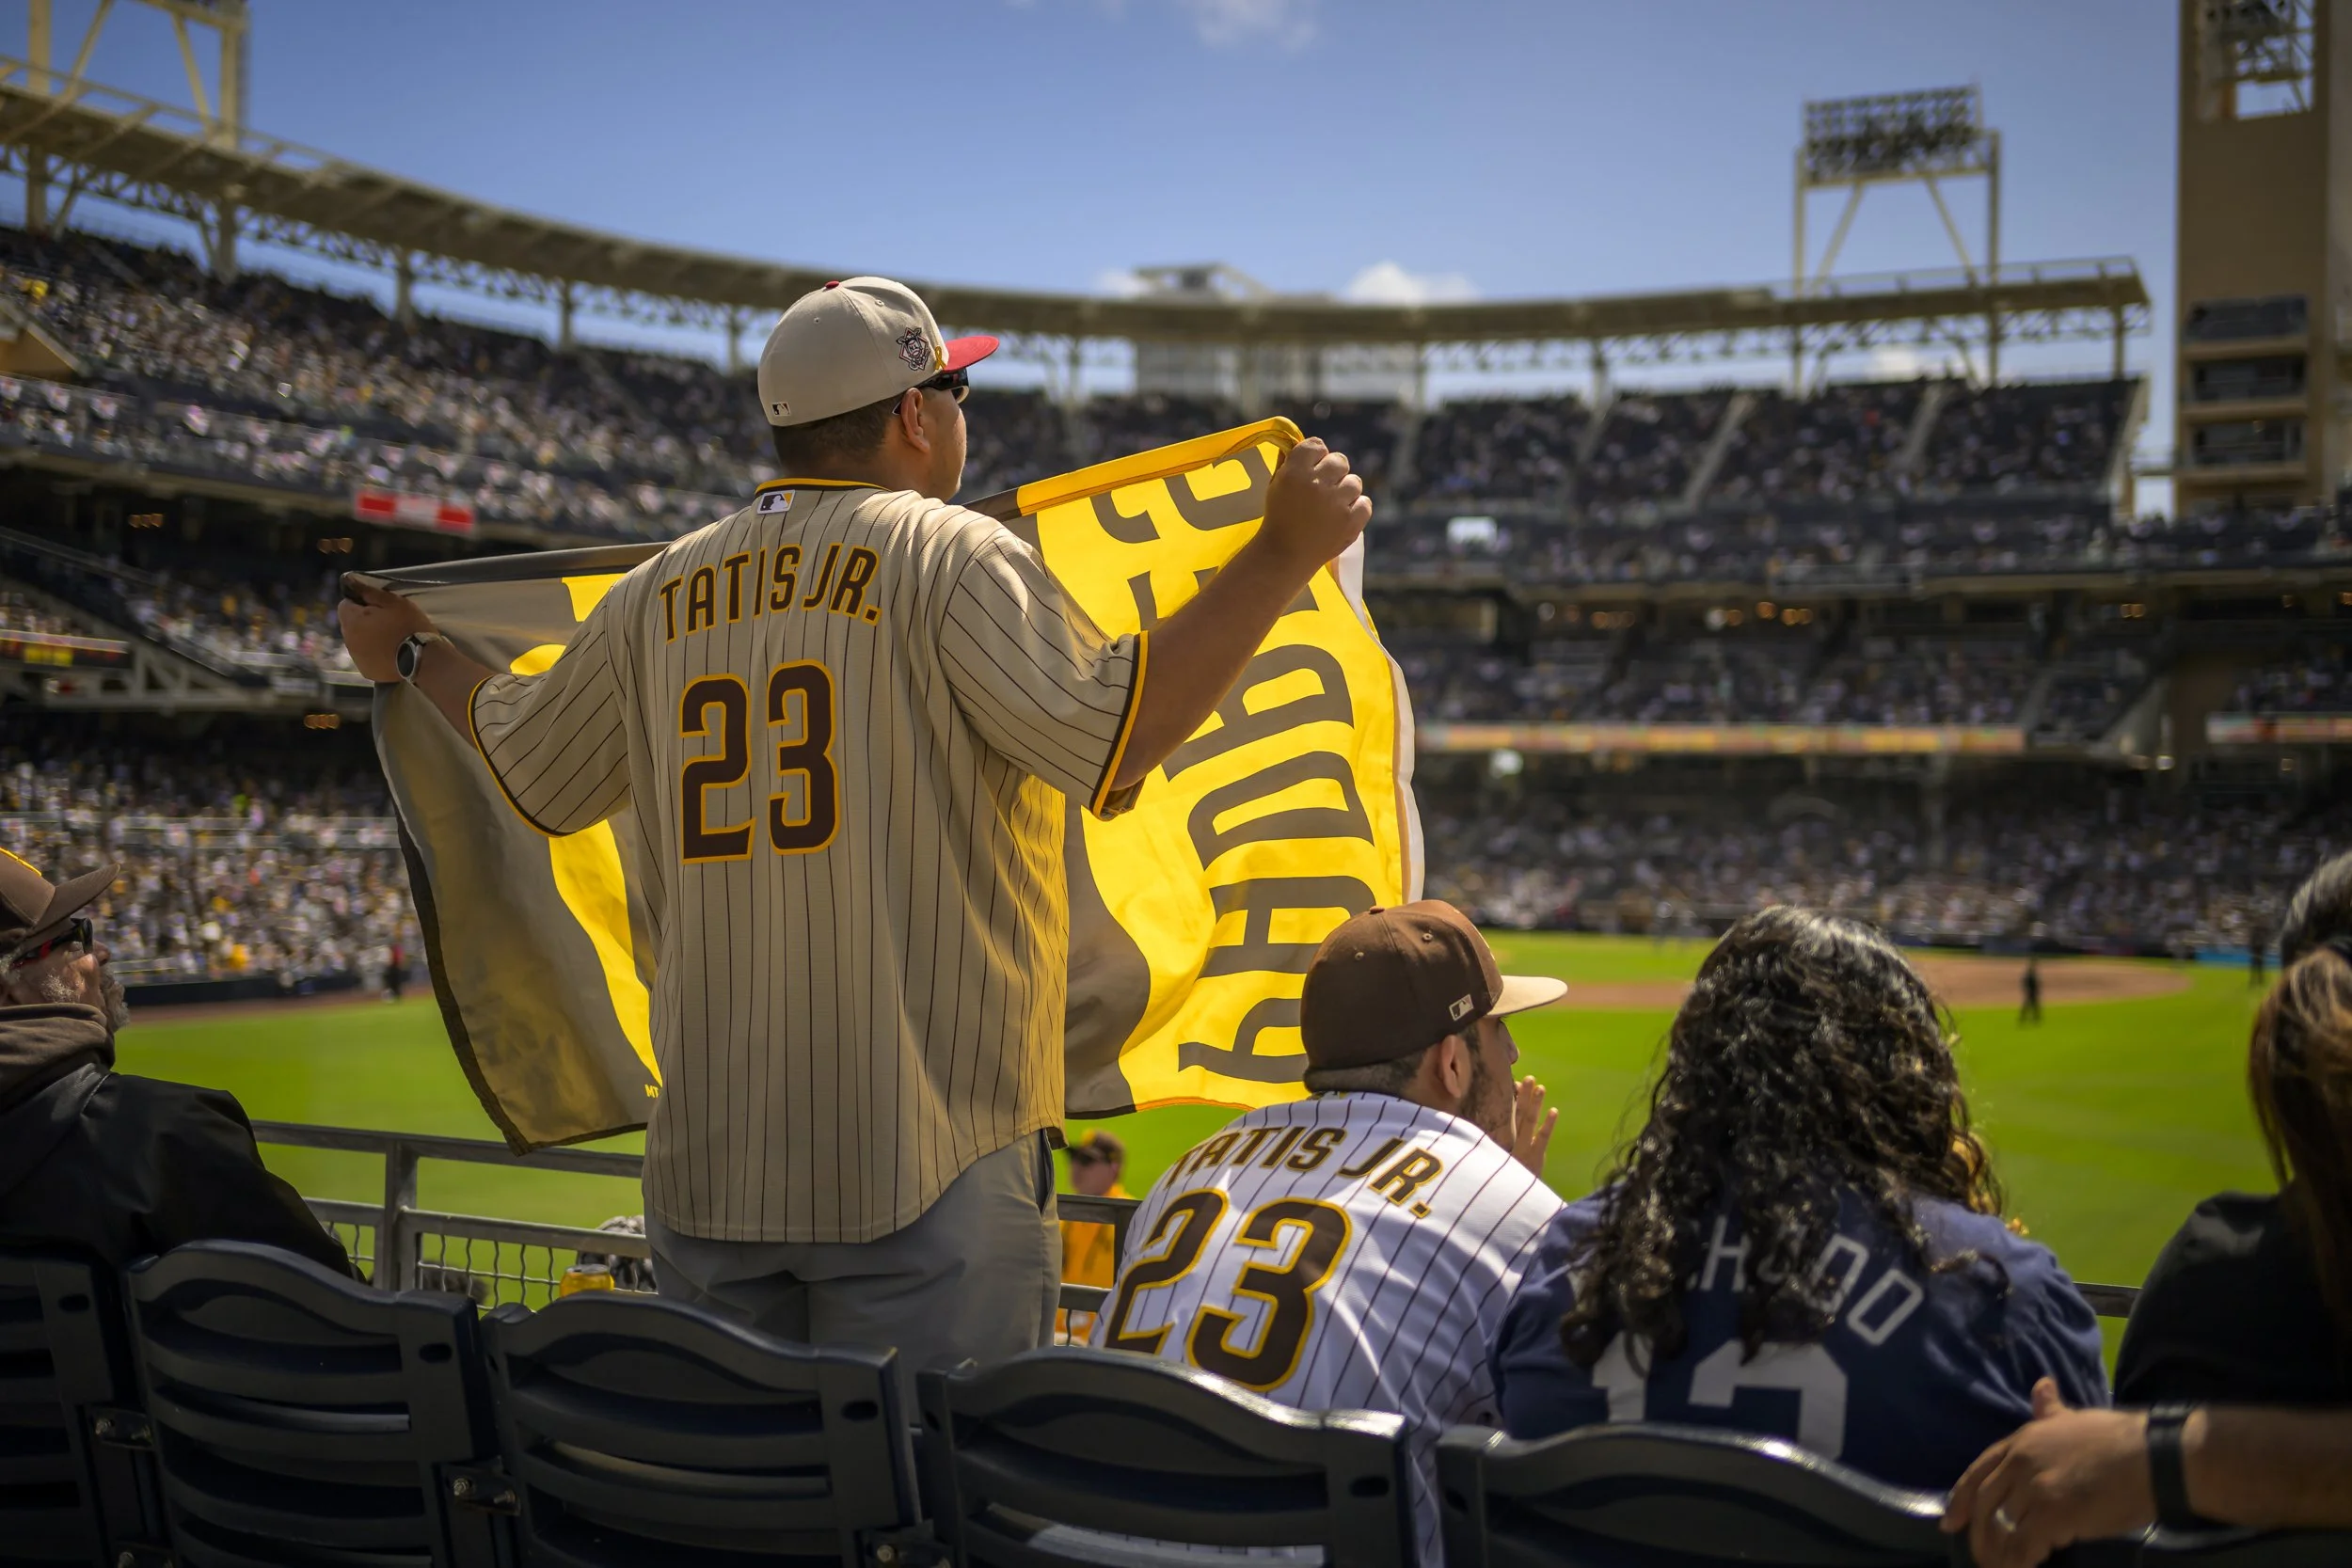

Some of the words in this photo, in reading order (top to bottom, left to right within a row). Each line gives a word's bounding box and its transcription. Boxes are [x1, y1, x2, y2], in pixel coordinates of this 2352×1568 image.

[660, 544, 802, 644] TATIS
[801, 543, 882, 626] JR.
[678, 658, 841, 864] 23
[1163, 1126, 1347, 1191] TATIS
[1337, 1136, 1444, 1219] JR.
[1104, 1187, 1353, 1392] 23
